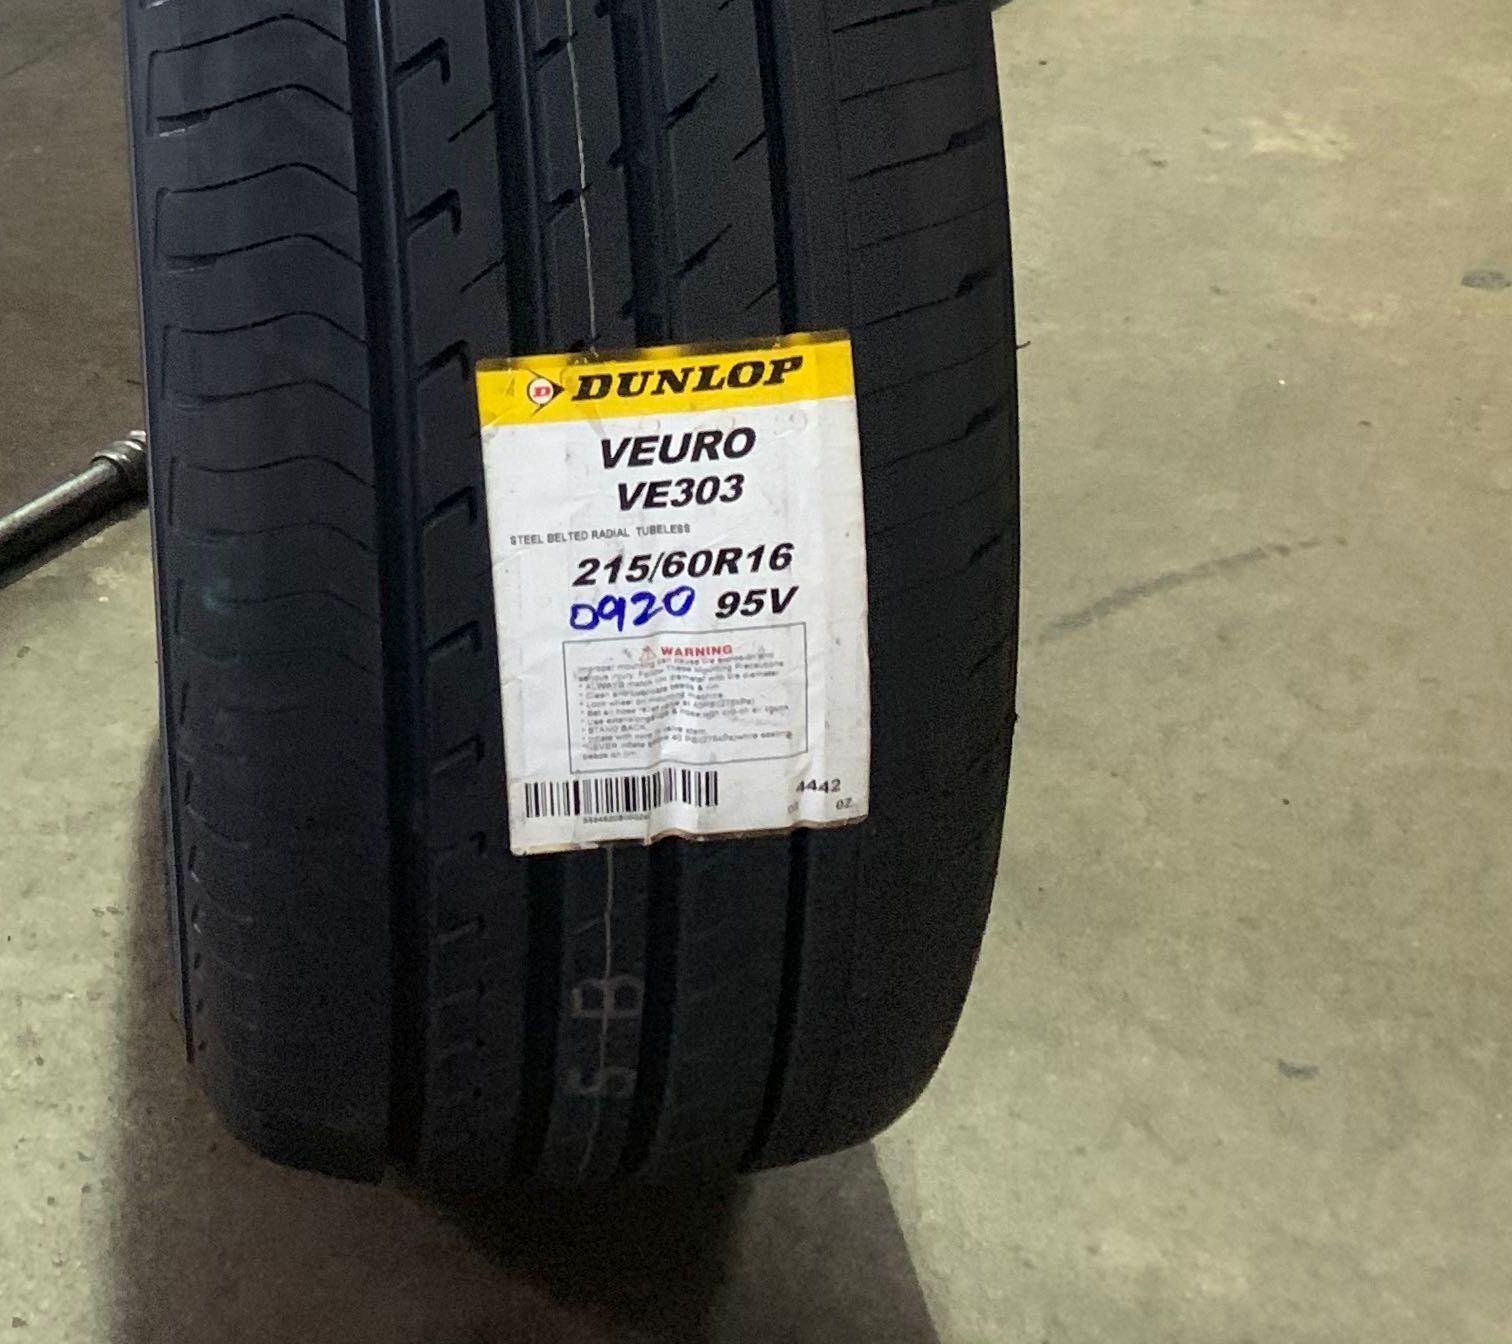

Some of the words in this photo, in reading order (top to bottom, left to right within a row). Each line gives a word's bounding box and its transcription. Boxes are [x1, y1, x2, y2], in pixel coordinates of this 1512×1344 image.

[571, 355, 804, 402] DUNLOP
[601, 426, 757, 469] VEURO
[618, 473, 745, 511] VE303
[509, 534, 544, 546] STEEL
[546, 530, 589, 544] BELTED
[591, 527, 631, 540] RADIAL
[635, 523, 691, 537] TUBELESS
[573, 542, 795, 586] 215/60R16
[570, 584, 697, 632] 0920
[715, 585, 799, 619] 95V
[660, 643, 733, 658] WARNING
[795, 777, 841, 794] 4442
